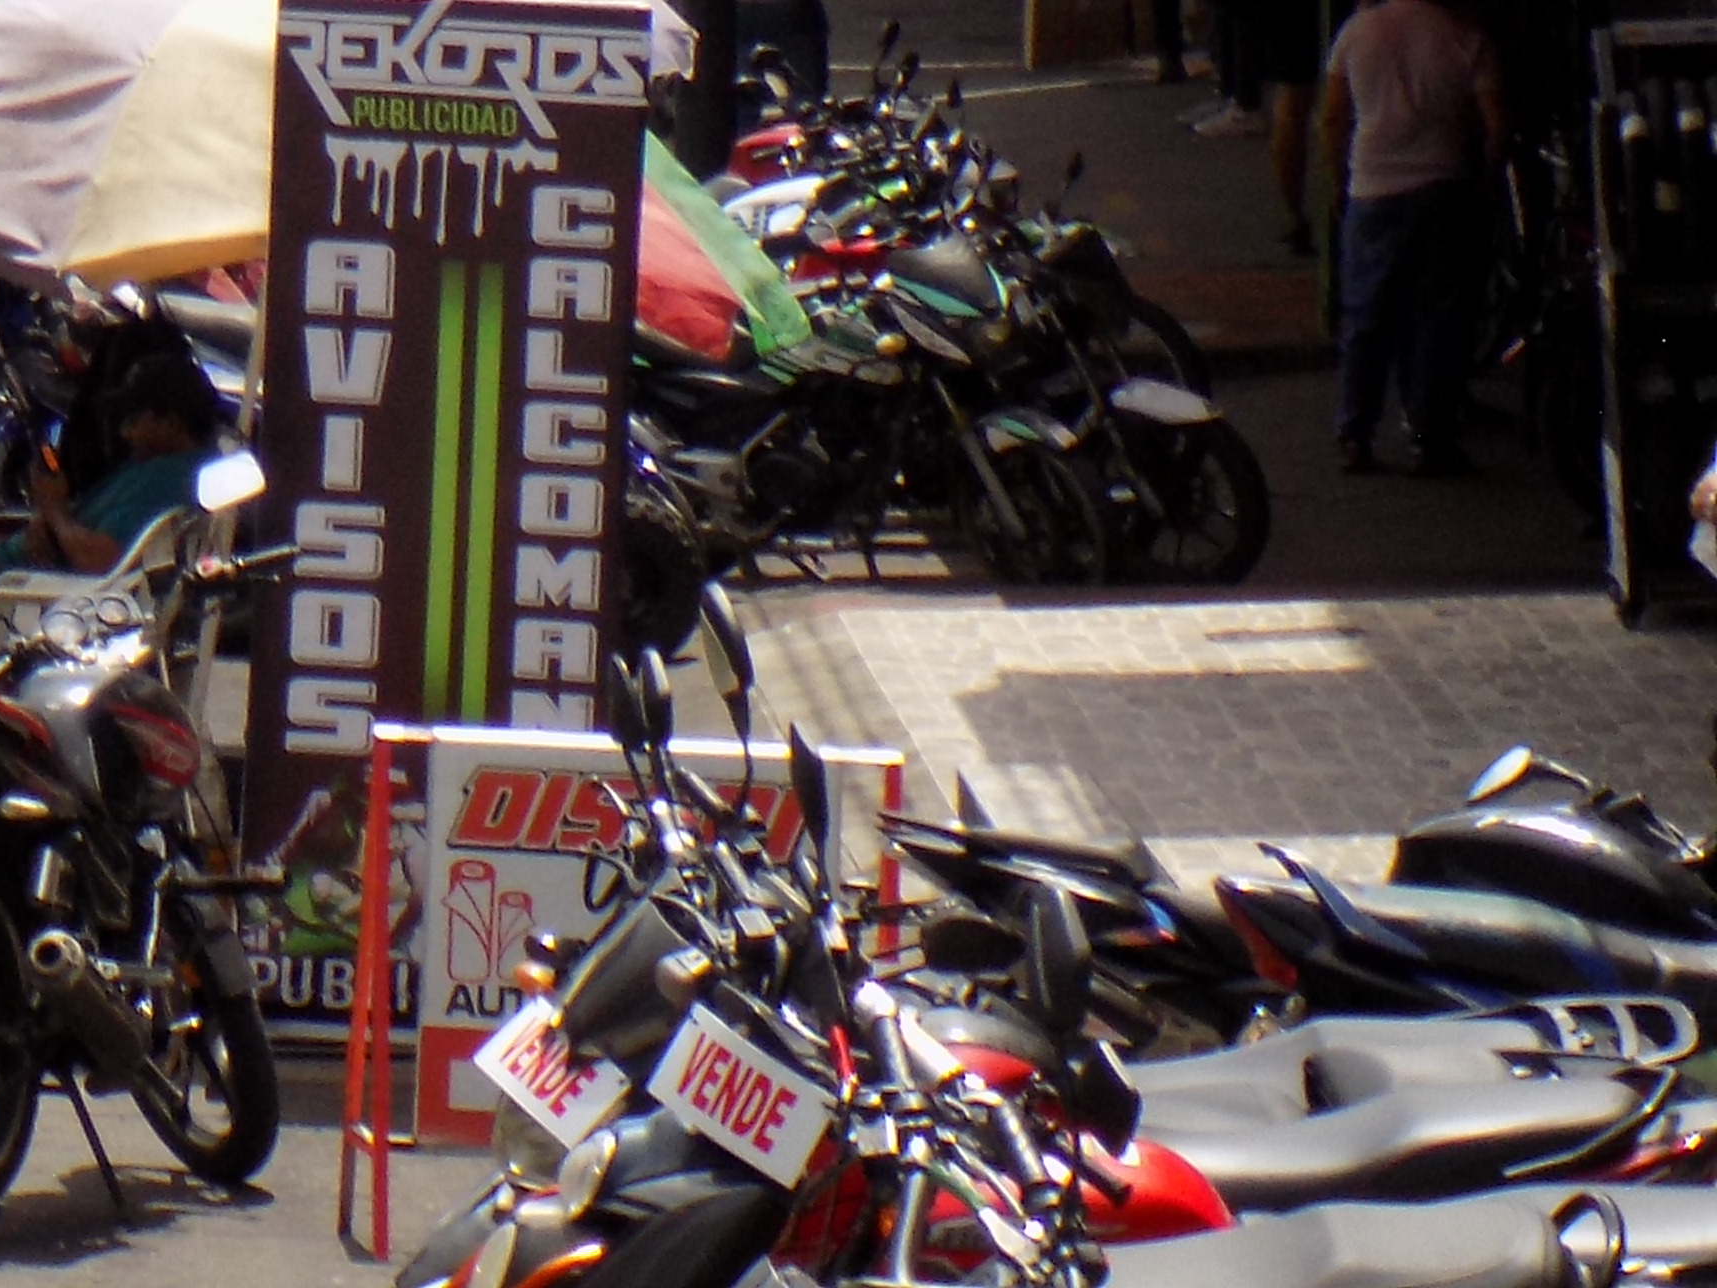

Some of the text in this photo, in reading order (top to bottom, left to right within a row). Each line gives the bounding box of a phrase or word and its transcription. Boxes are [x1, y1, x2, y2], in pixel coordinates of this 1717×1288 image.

[352, 96, 519, 139] PUBLICIDAD
[285, 238, 396, 756] AVISOS
[676, 1031, 798, 1155] VENDE
